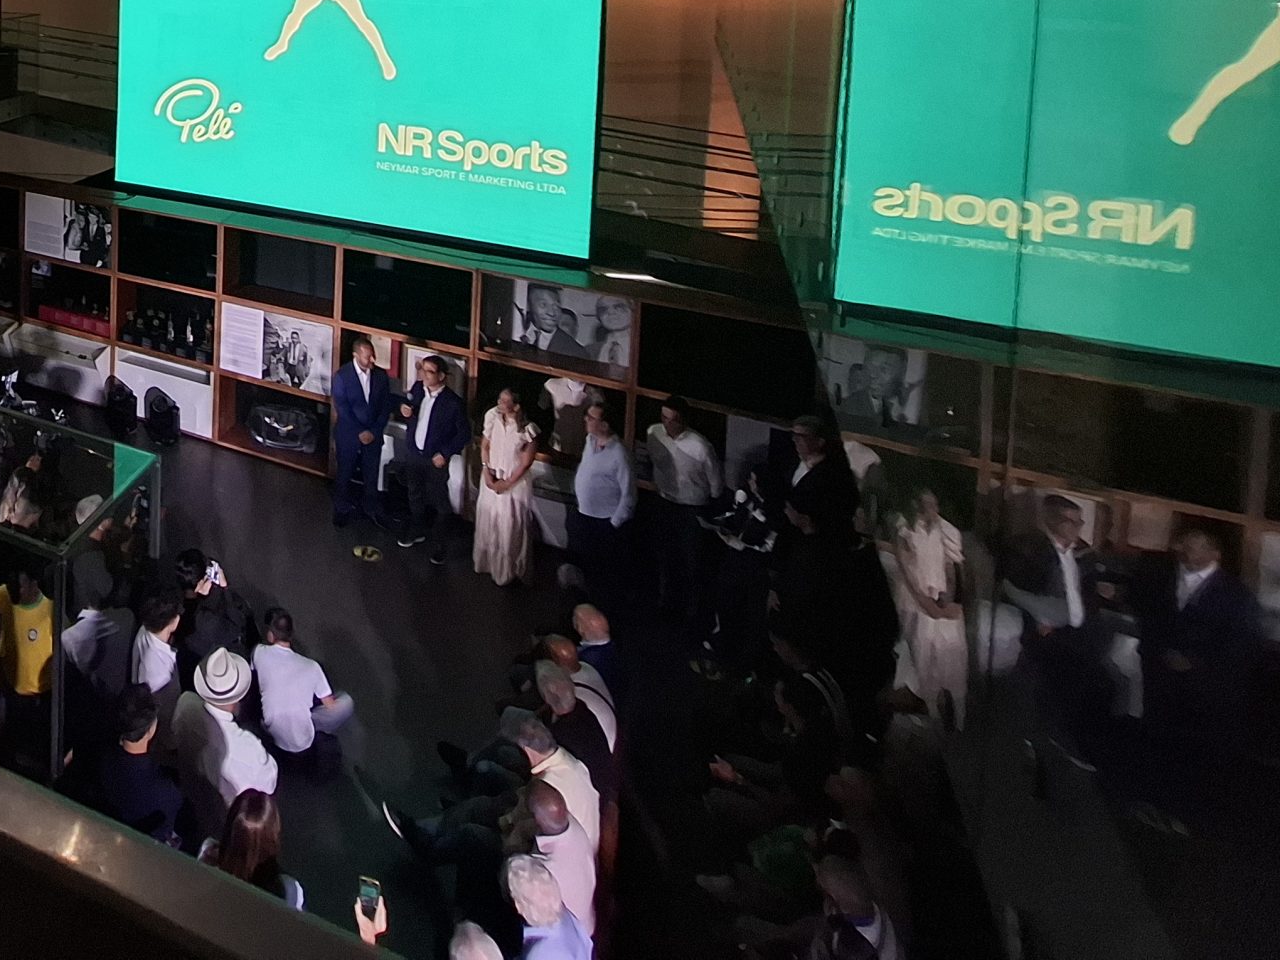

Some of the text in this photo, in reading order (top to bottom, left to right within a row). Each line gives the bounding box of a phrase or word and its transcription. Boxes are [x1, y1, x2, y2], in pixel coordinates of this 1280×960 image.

[154, 78, 243, 144] Pelé
[377, 122, 568, 176] NR Sports
[376, 161, 567, 195] NEYMAR SPORT E MARKETING LTDA
